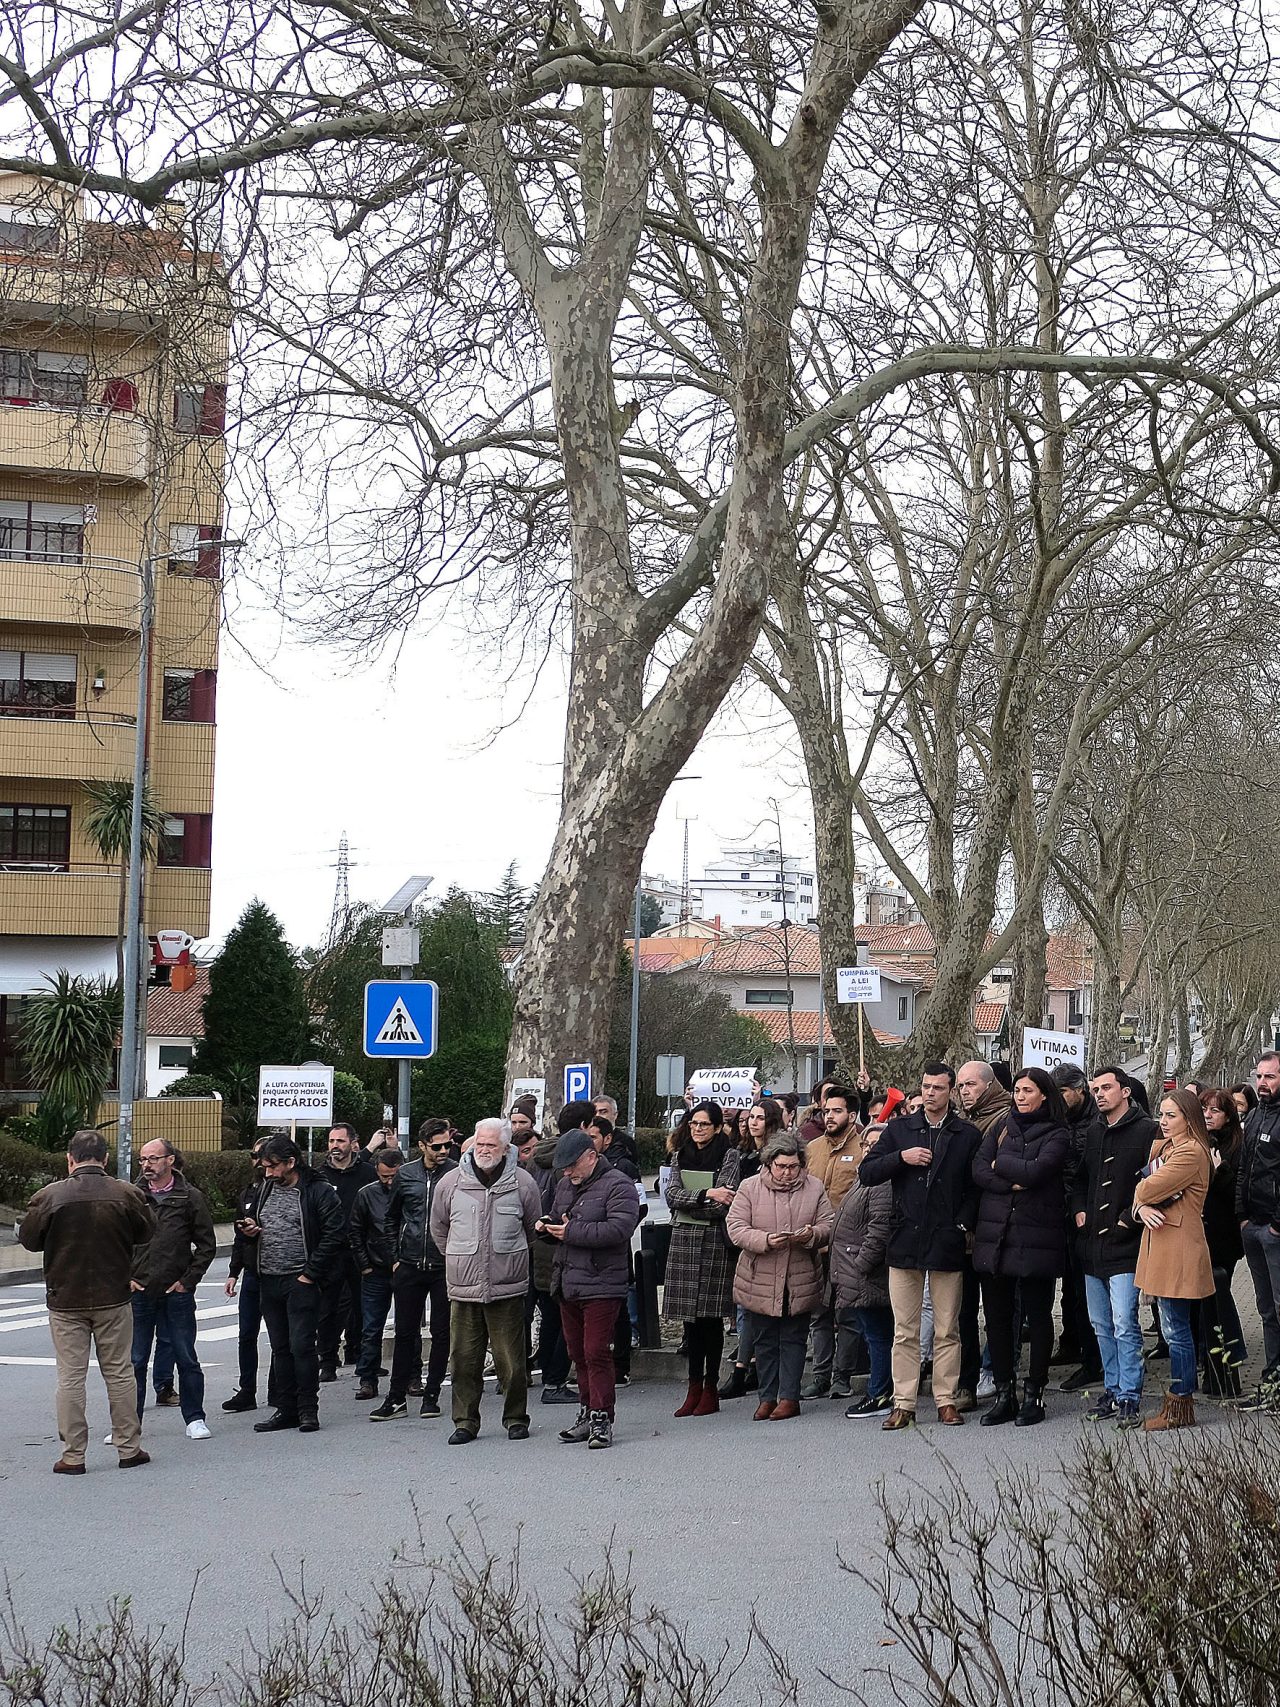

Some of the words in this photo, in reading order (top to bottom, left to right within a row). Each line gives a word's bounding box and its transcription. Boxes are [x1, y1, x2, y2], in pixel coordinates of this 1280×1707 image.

[839, 969, 879, 977] CUMPRA-SE
[1030, 1037, 1078, 1056] VÍTIMAS
[1044, 1056, 1062, 1067] DO
[699, 1069, 750, 1079] VÍTIMAS
[262, 1088, 299, 1097] ENQUANTO
[569, 1072, 586, 1103] P
[711, 1082, 731, 1093] DO
[262, 1095, 329, 1107] PRECÁRIOS
